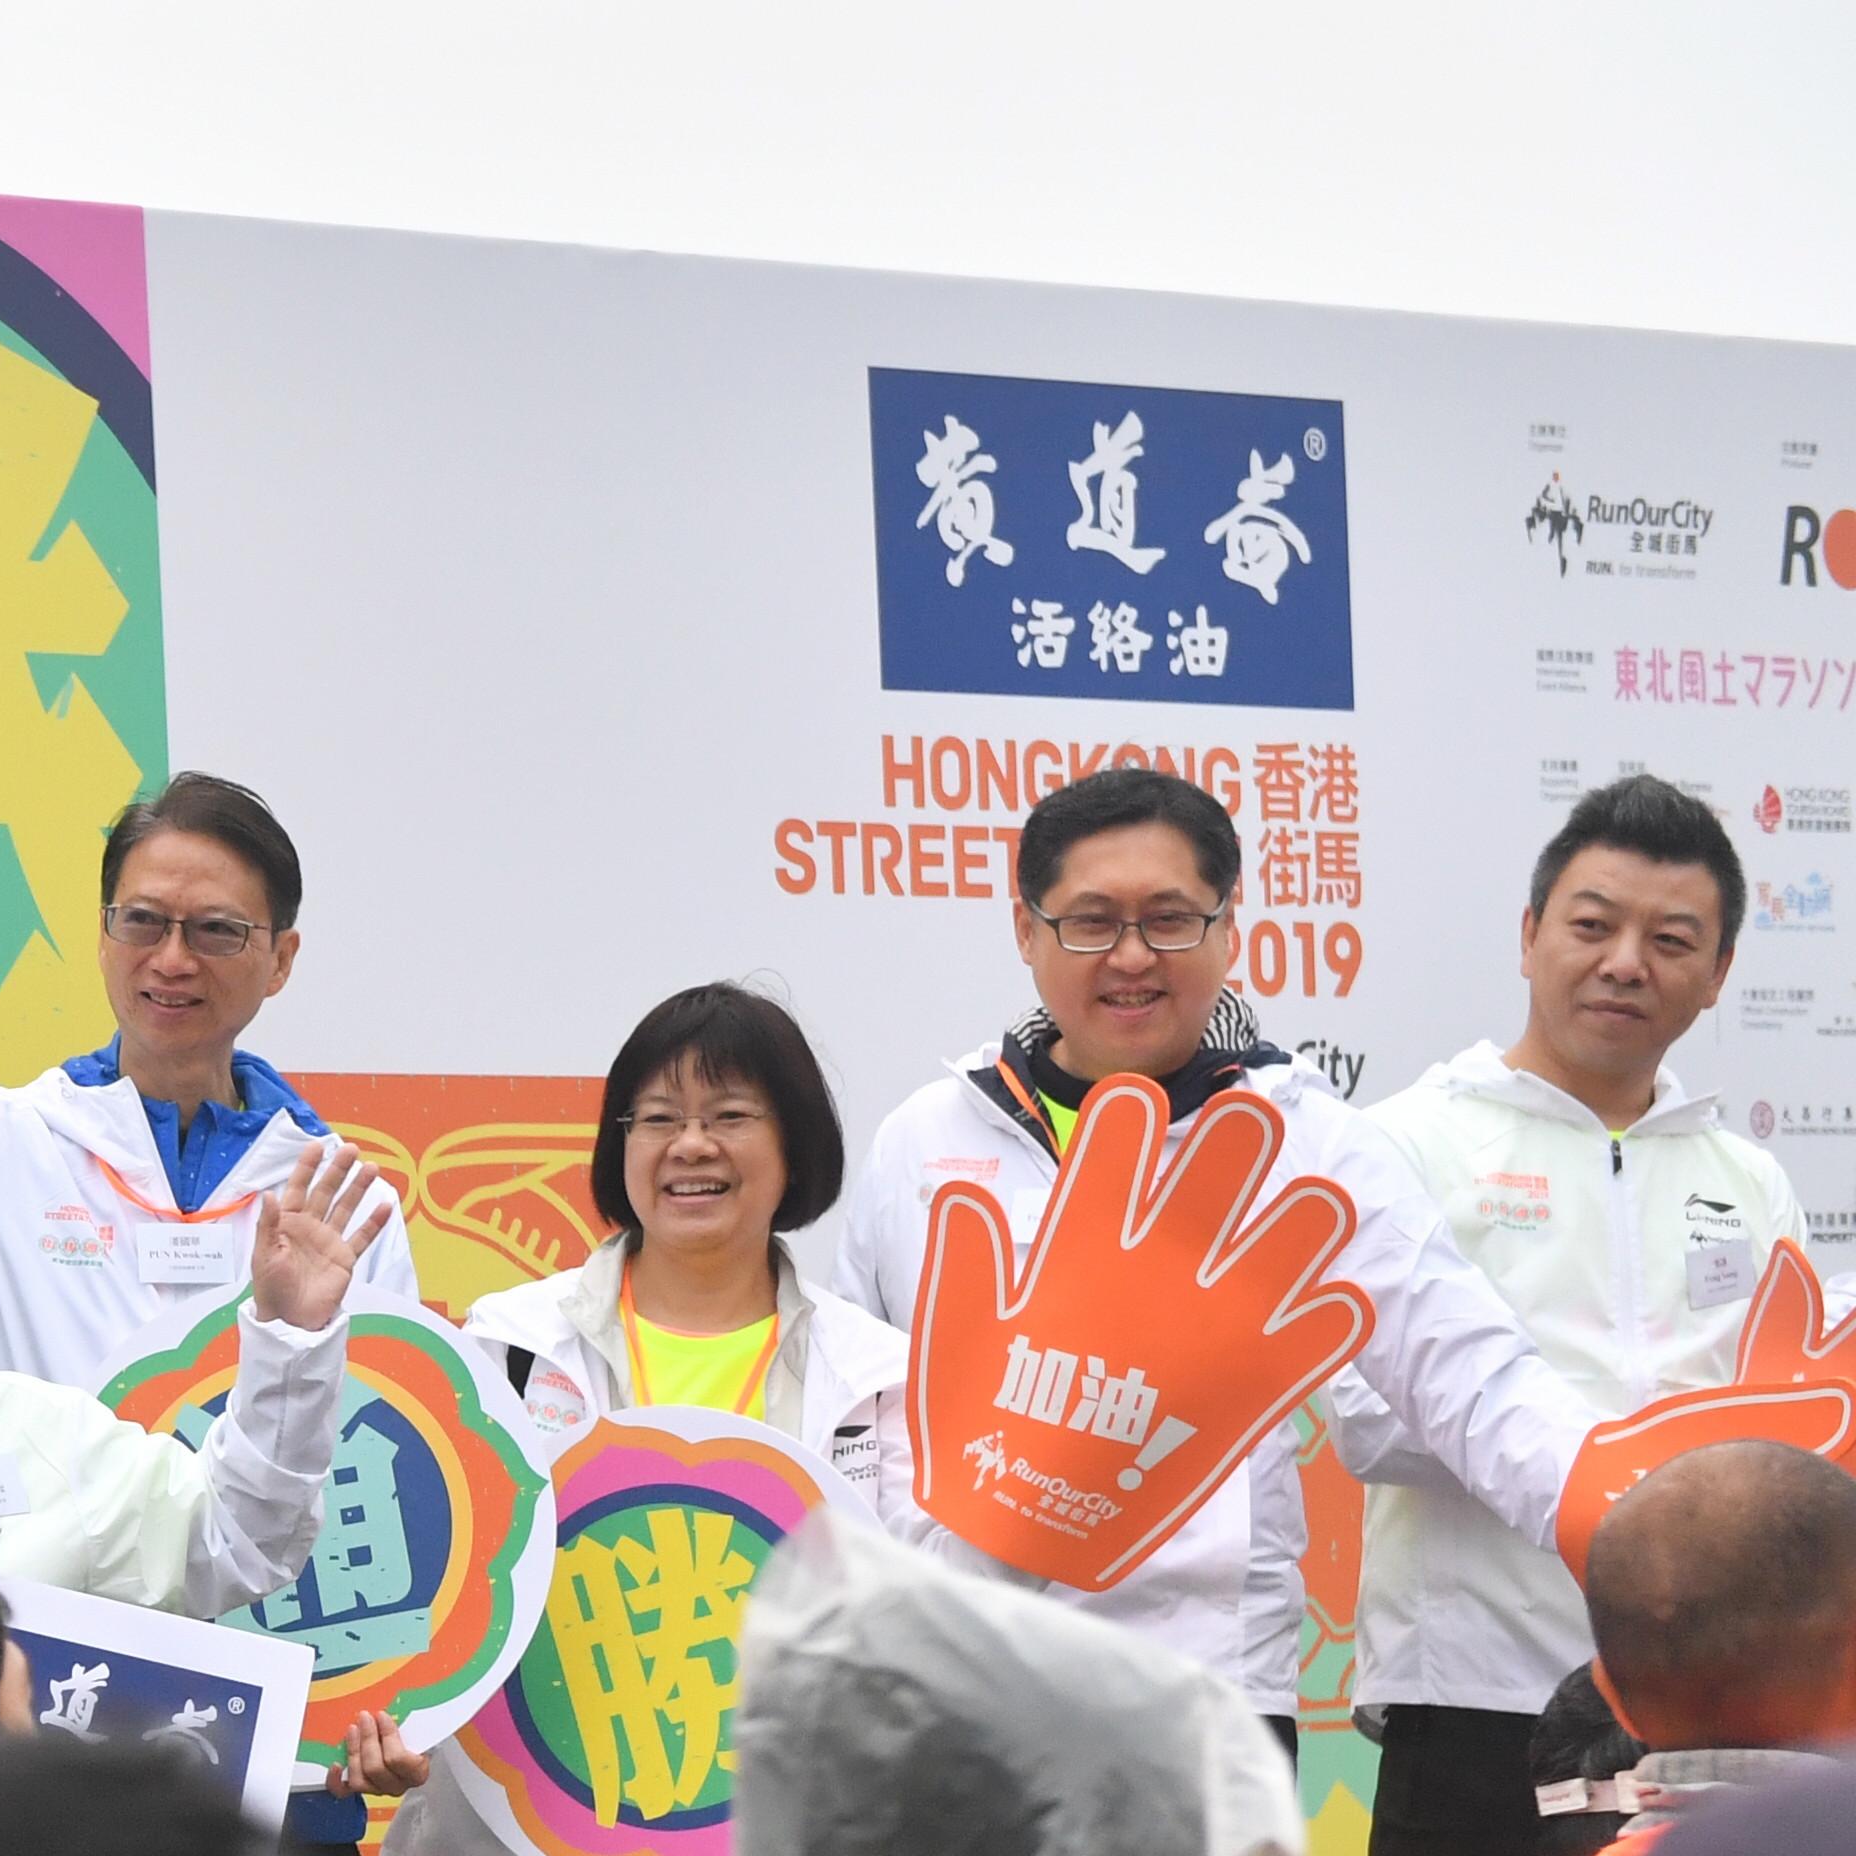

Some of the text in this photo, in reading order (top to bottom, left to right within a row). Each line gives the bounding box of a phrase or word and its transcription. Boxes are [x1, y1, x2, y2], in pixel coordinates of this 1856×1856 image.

[1587, 495, 1713, 537] RunOurCity
[1010, 597, 1229, 679] 活絡油
[881, 735, 1359, 824] HONGG 香港
[1259, 827, 1362, 909] 街馬
[1009, 1457, 1123, 1520] RunOurCity
